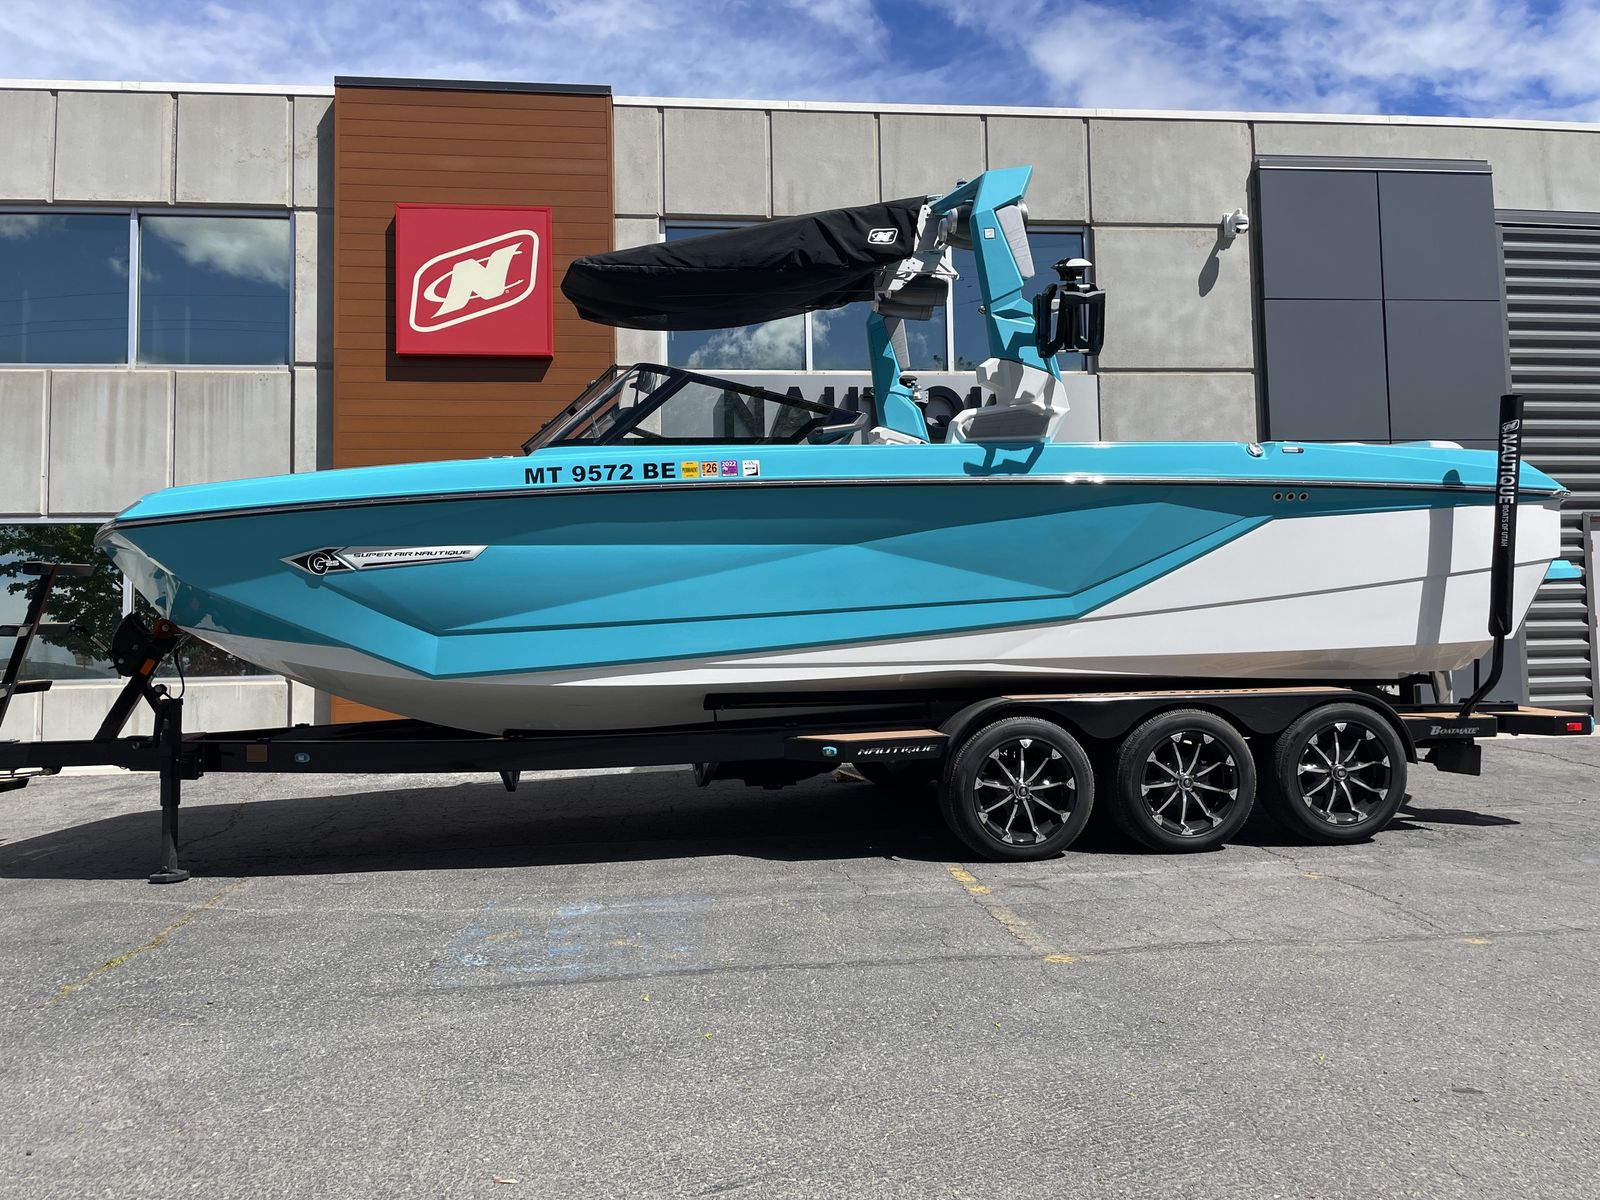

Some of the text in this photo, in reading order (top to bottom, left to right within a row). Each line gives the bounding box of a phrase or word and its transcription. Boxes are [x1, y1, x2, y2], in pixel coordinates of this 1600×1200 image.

[525, 462, 676, 484] MT 9572 BE
[706, 463, 718, 473] 26
[1499, 433, 1518, 504] NAUTIQUE
[1501, 523, 1509, 531] OF
[1500, 531, 1509, 547] UTAH
[857, 744, 938, 756] NAUTIQUE
